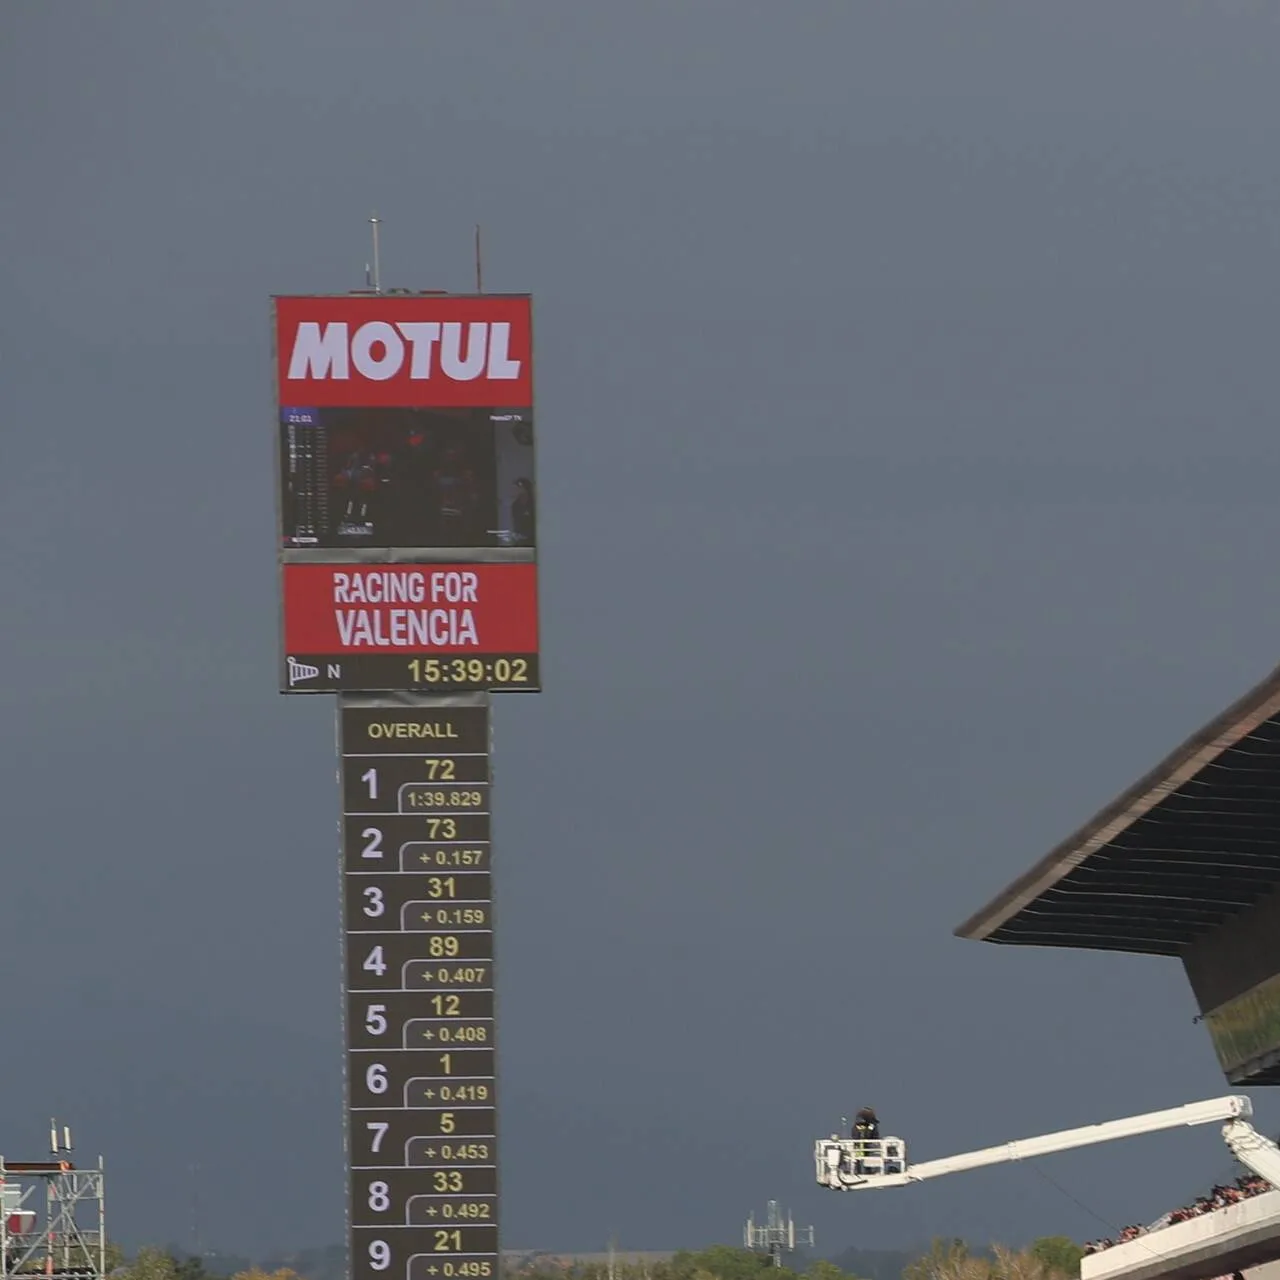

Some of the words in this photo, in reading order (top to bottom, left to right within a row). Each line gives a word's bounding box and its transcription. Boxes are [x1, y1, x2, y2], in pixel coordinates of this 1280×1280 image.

[288, 321, 520, 381] MOTUL
[334, 572, 424, 603] RACING
[431, 572, 478, 603] FOR
[335, 608, 479, 646] VALENCIA
[328, 664, 340, 679] N
[408, 658, 527, 683] 15:39:02
[368, 722, 458, 739] OVERALL
[425, 760, 455, 780] 72
[361, 769, 378, 799] 1
[408, 792, 481, 806] 1:39.829
[426, 819, 456, 839] 73
[361, 828, 383, 858] 2
[428, 877, 455, 898] 31
[363, 887, 385, 917] 3
[429, 936, 458, 957] 89
[363, 946, 386, 976] 4
[431, 995, 460, 1016] 12
[366, 1005, 387, 1035] 5
[440, 1053, 451, 1075] 1
[366, 1064, 388, 1093] 6
[440, 1112, 455, 1134] 5
[366, 1122, 389, 1152] 7
[433, 1172, 463, 1192] 33
[368, 1181, 390, 1211] 8
[434, 1230, 461, 1251] 21
[369, 1240, 390, 1271] 9
